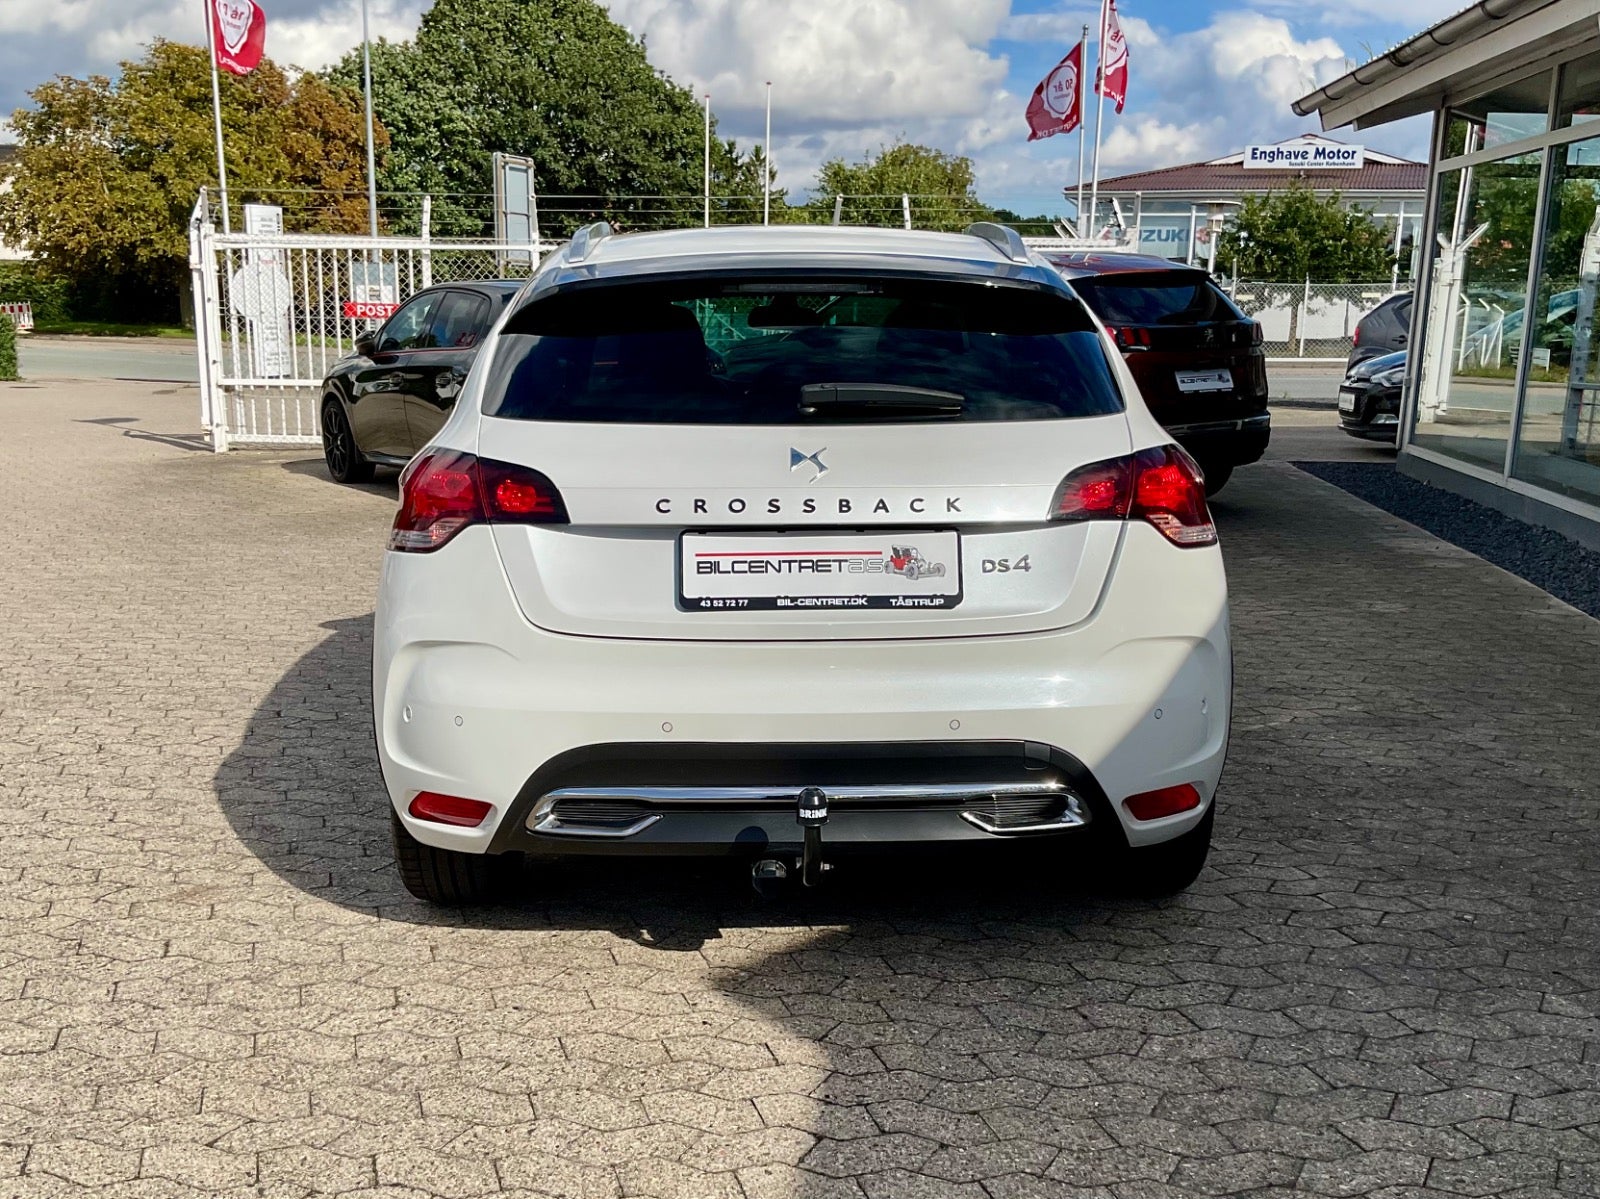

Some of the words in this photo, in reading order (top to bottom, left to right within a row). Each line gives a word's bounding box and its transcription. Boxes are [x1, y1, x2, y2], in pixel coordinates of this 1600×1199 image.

[1251, 147, 1308, 163] Enghave
[1313, 147, 1357, 160] Motor
[356, 304, 394, 316] POST
[655, 496, 962, 514] CROSSBACK
[776, 597, 868, 607] BIL-CENTRET.DK
[889, 597, 945, 607] TÅSTRUP
